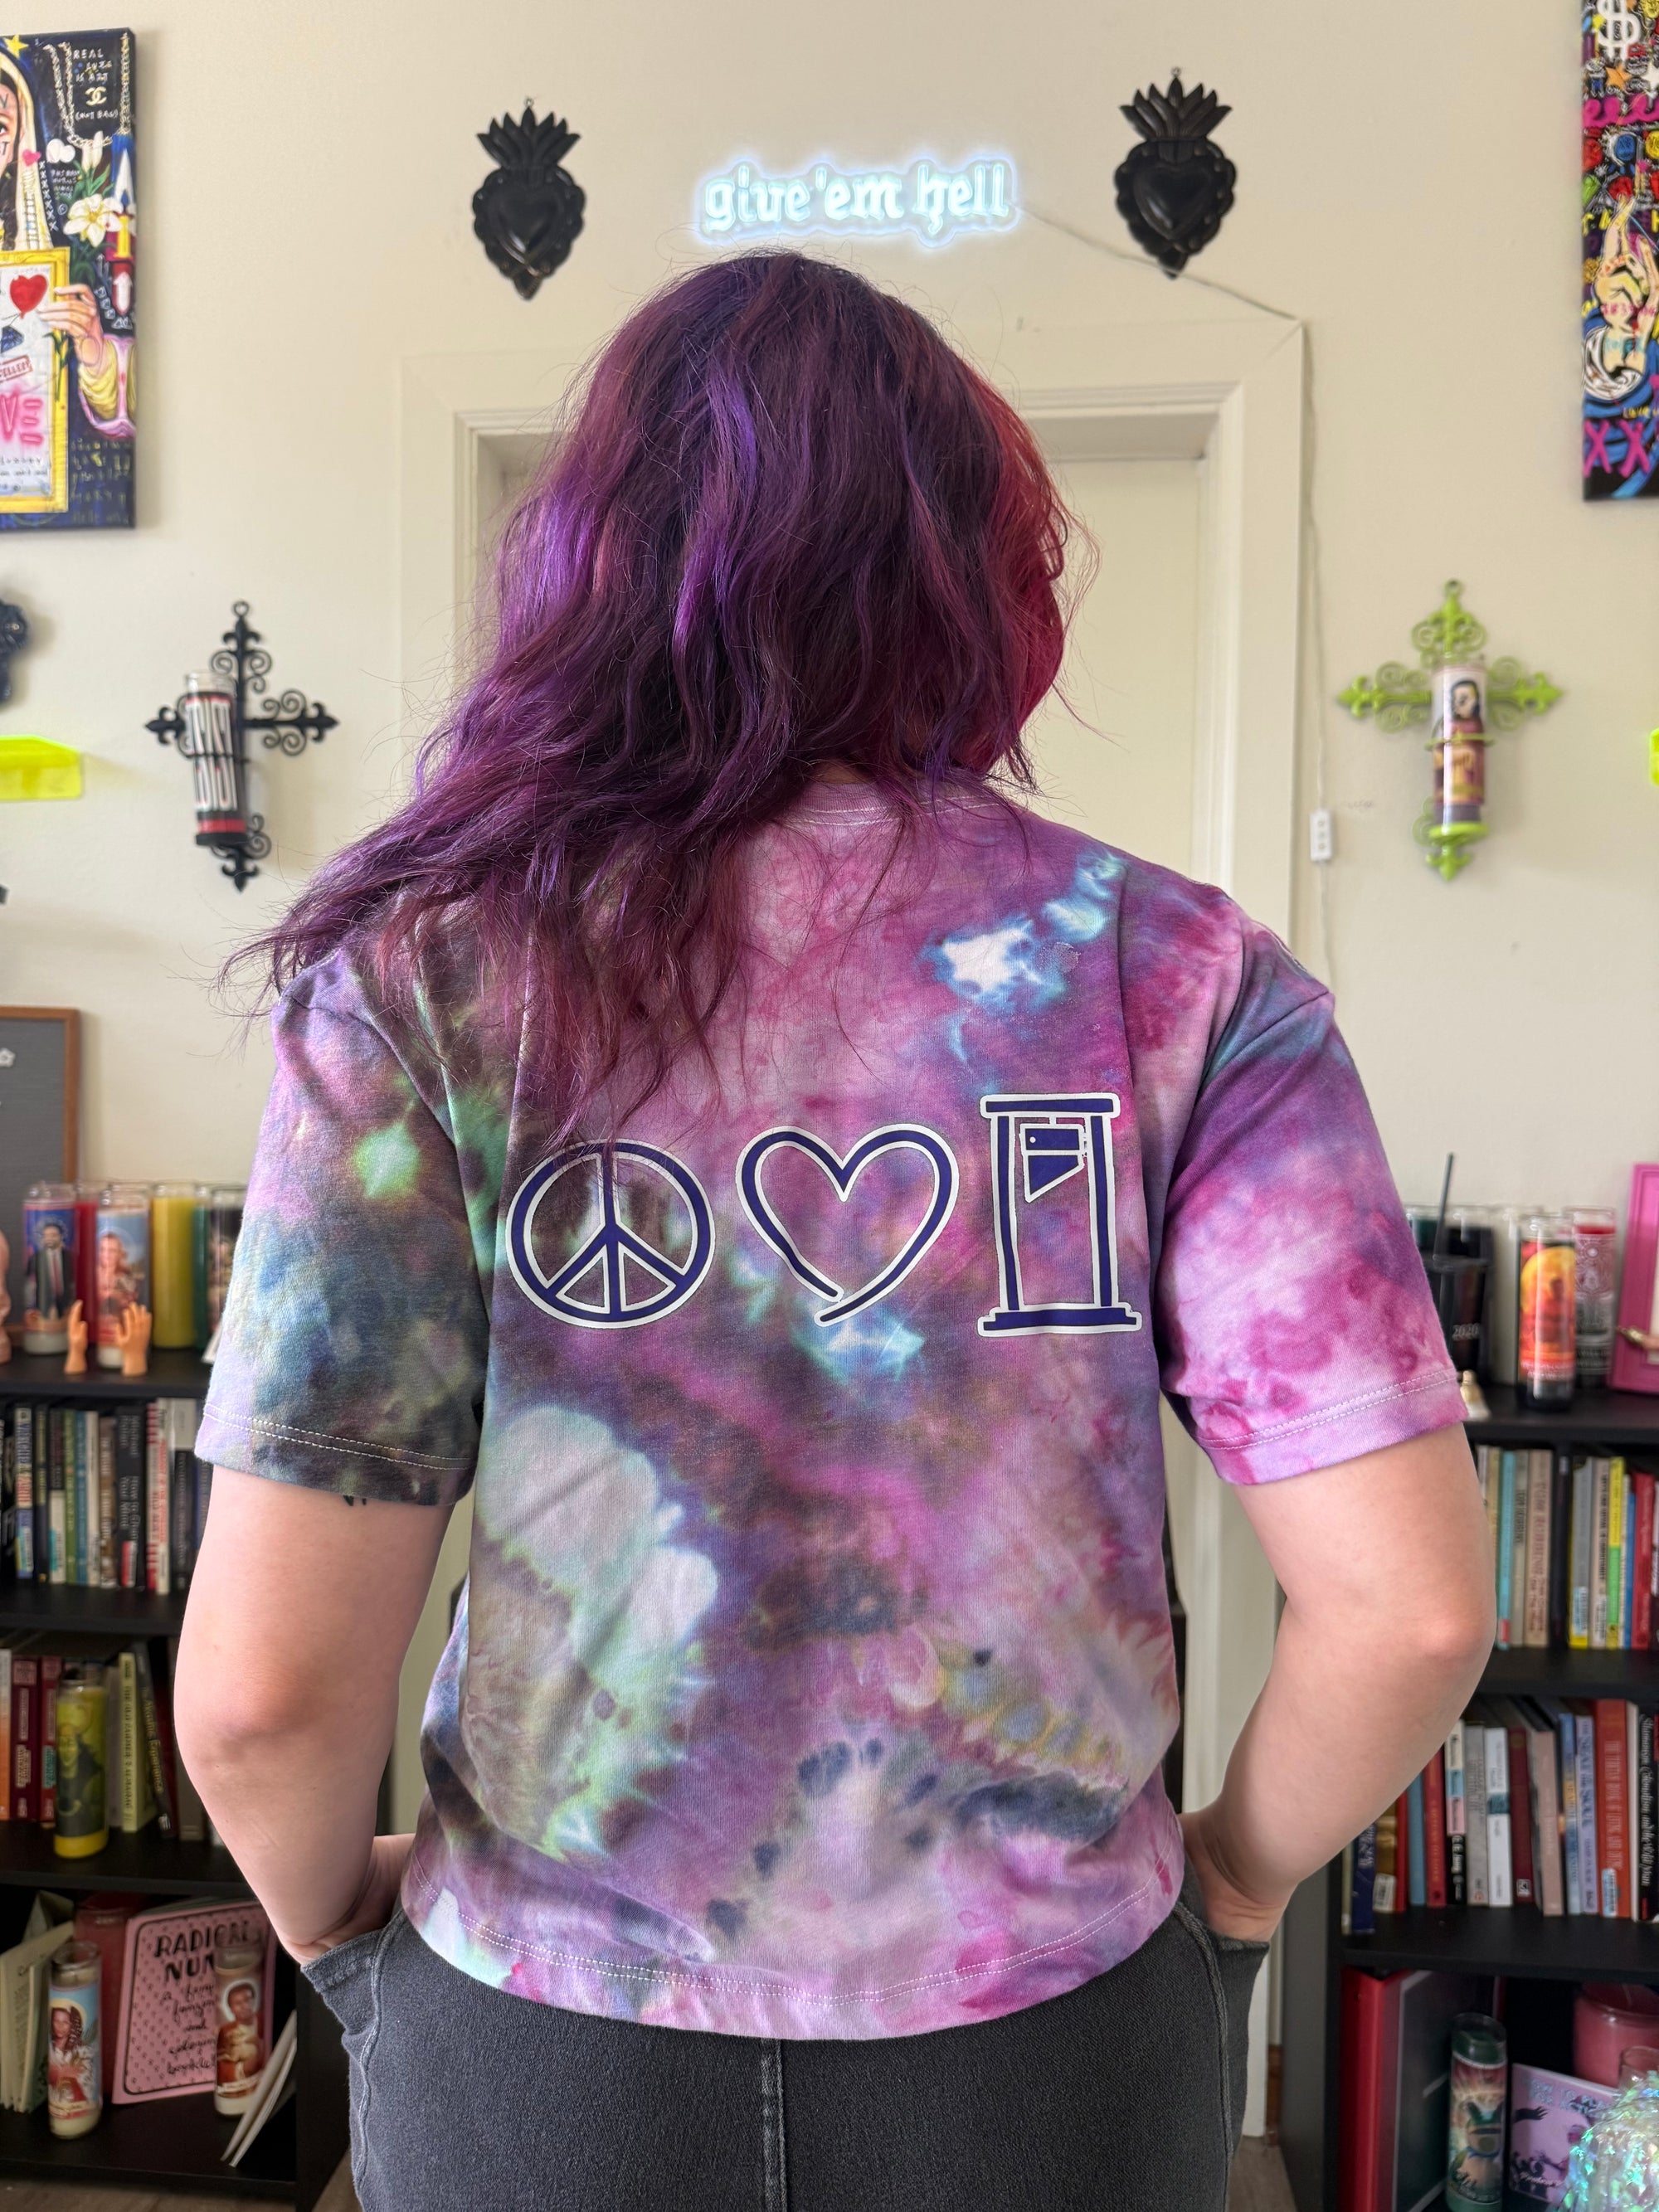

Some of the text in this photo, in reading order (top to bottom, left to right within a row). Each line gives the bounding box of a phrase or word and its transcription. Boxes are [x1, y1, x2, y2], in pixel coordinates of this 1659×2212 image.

[73, 48, 104, 59] REAL
[705, 163, 1010, 235] give 'em hell
